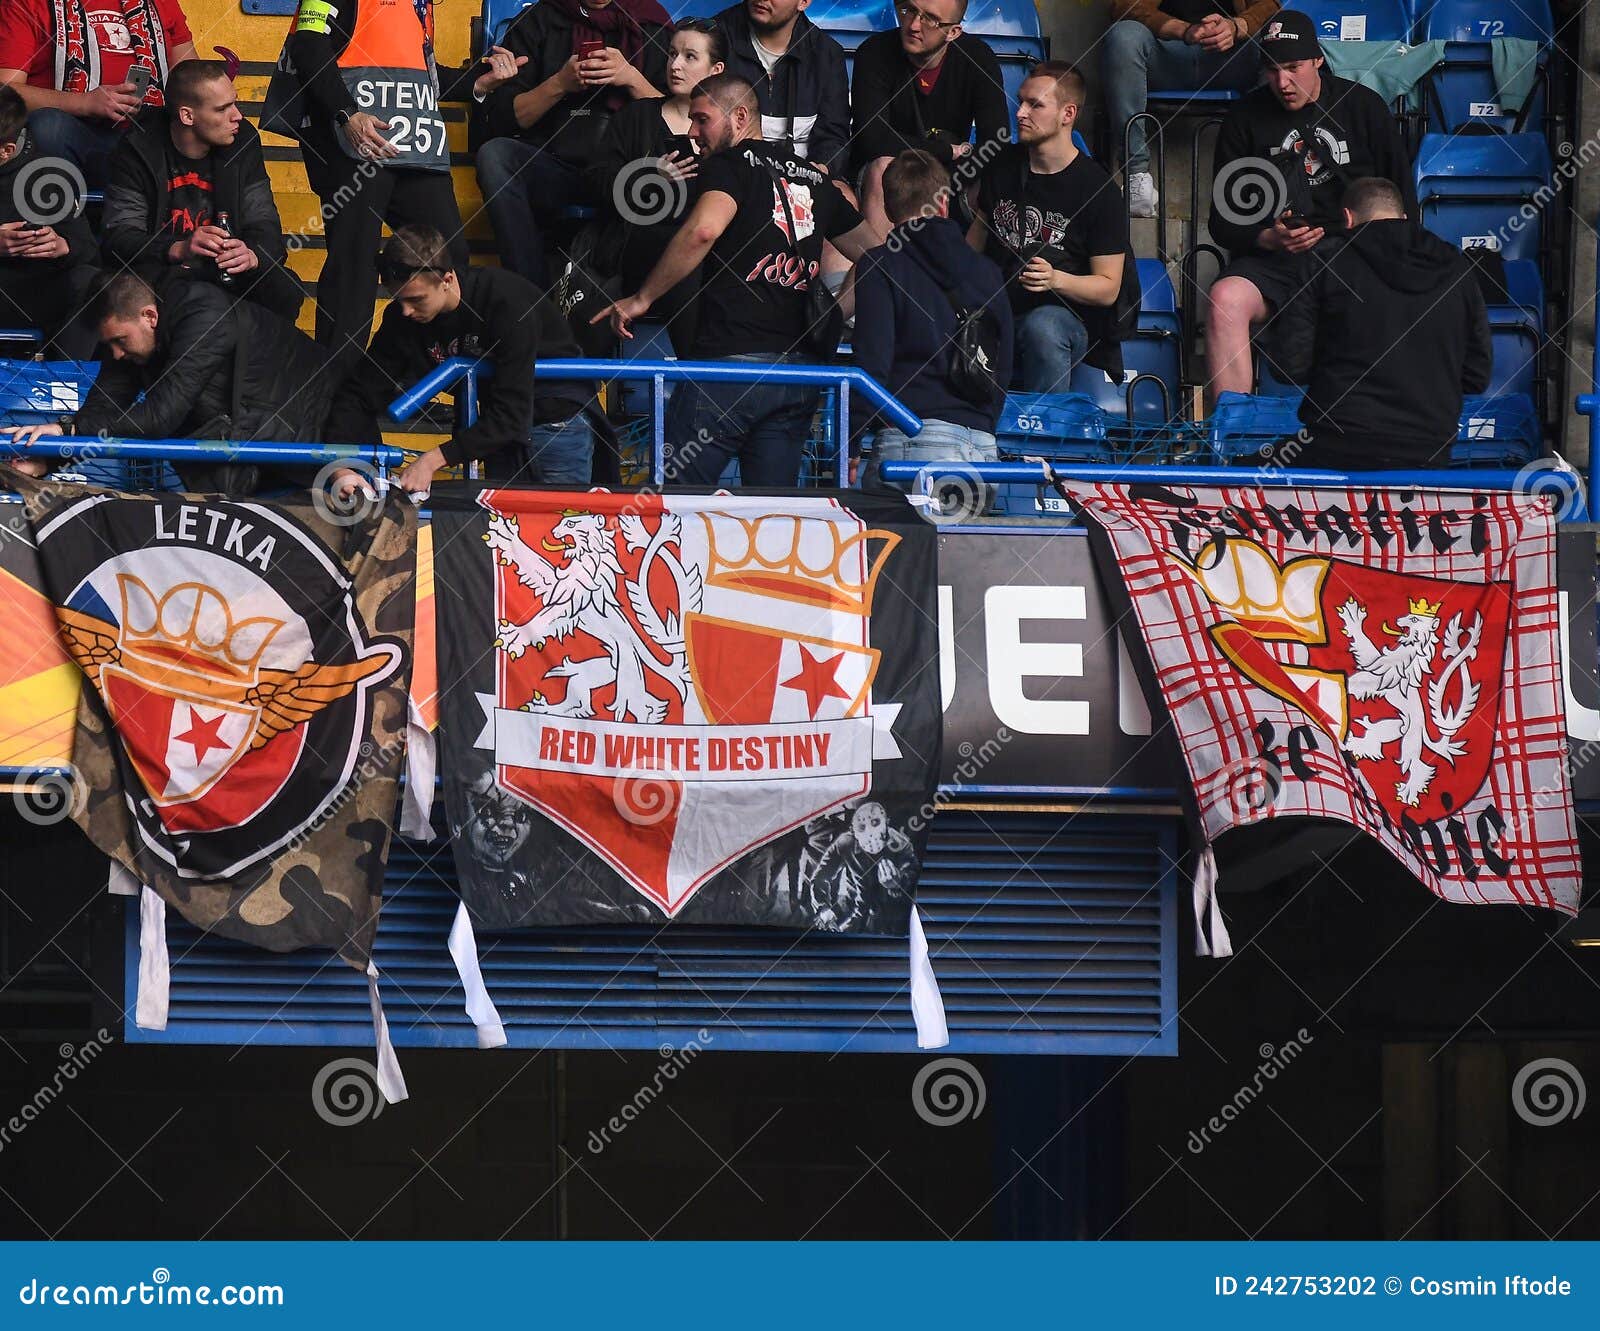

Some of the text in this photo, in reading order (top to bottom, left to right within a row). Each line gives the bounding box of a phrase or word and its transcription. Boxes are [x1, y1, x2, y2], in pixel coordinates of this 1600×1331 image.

[1479, 20, 1504, 36] 72
[356, 79, 438, 112] STEW
[1477, 104, 1495, 115] 72
[388, 115, 446, 156] 257
[1469, 238, 1487, 249] 72
[154, 504, 277, 572] LETKA
[538, 726, 831, 771] RED WHITE DESTINY
